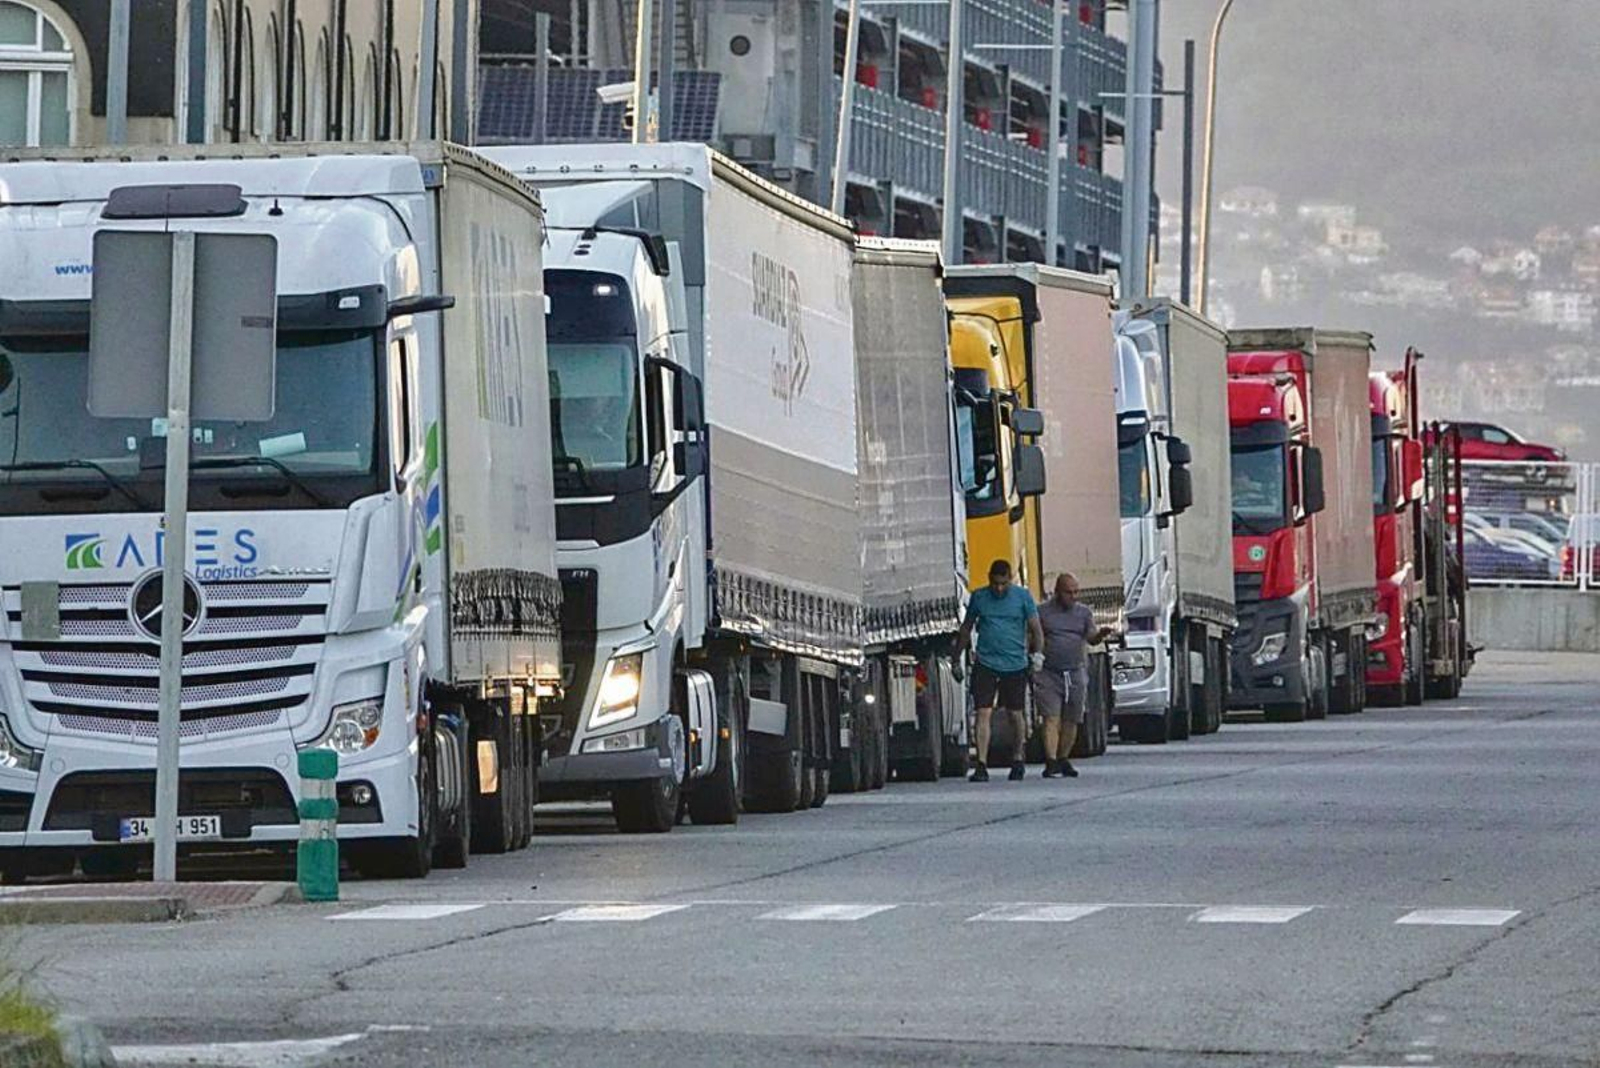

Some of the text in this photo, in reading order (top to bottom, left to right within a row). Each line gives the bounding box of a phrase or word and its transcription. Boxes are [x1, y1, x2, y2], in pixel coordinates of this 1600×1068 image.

[195, 564, 257, 581] Logistics
[131, 820, 149, 836] 34
[190, 818, 217, 835] 951
